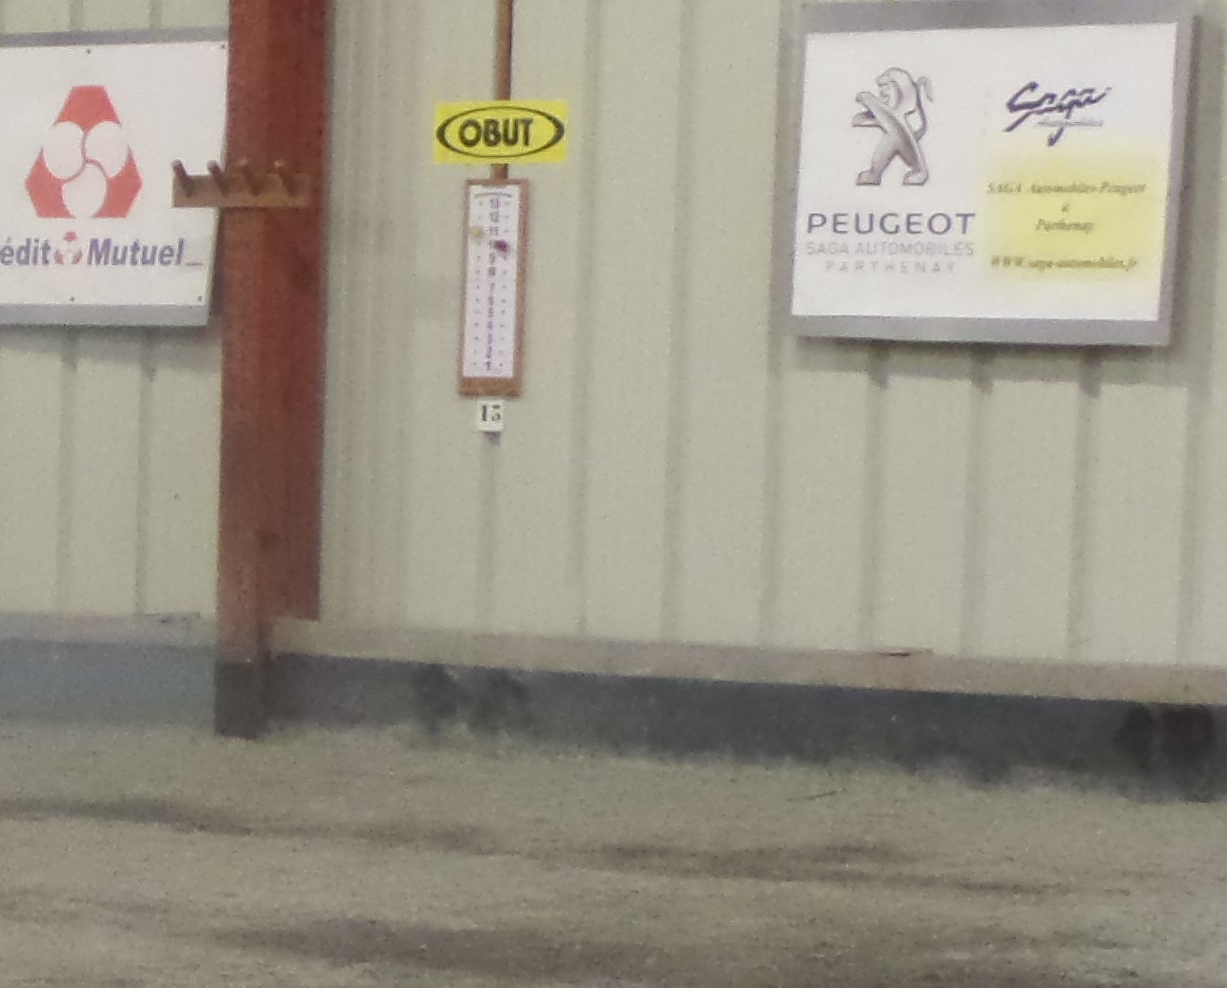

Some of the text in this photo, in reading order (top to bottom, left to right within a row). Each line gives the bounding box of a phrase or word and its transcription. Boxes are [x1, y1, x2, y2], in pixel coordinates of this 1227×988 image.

[459, 118, 534, 147] OBUT
[807, 213, 976, 235] PEUGEOT
[87, 237, 185, 266] Mutuel
[806, 241, 975, 256] SAGA AUTOMOBILES
[825, 260, 955, 274] PARTHENAY
